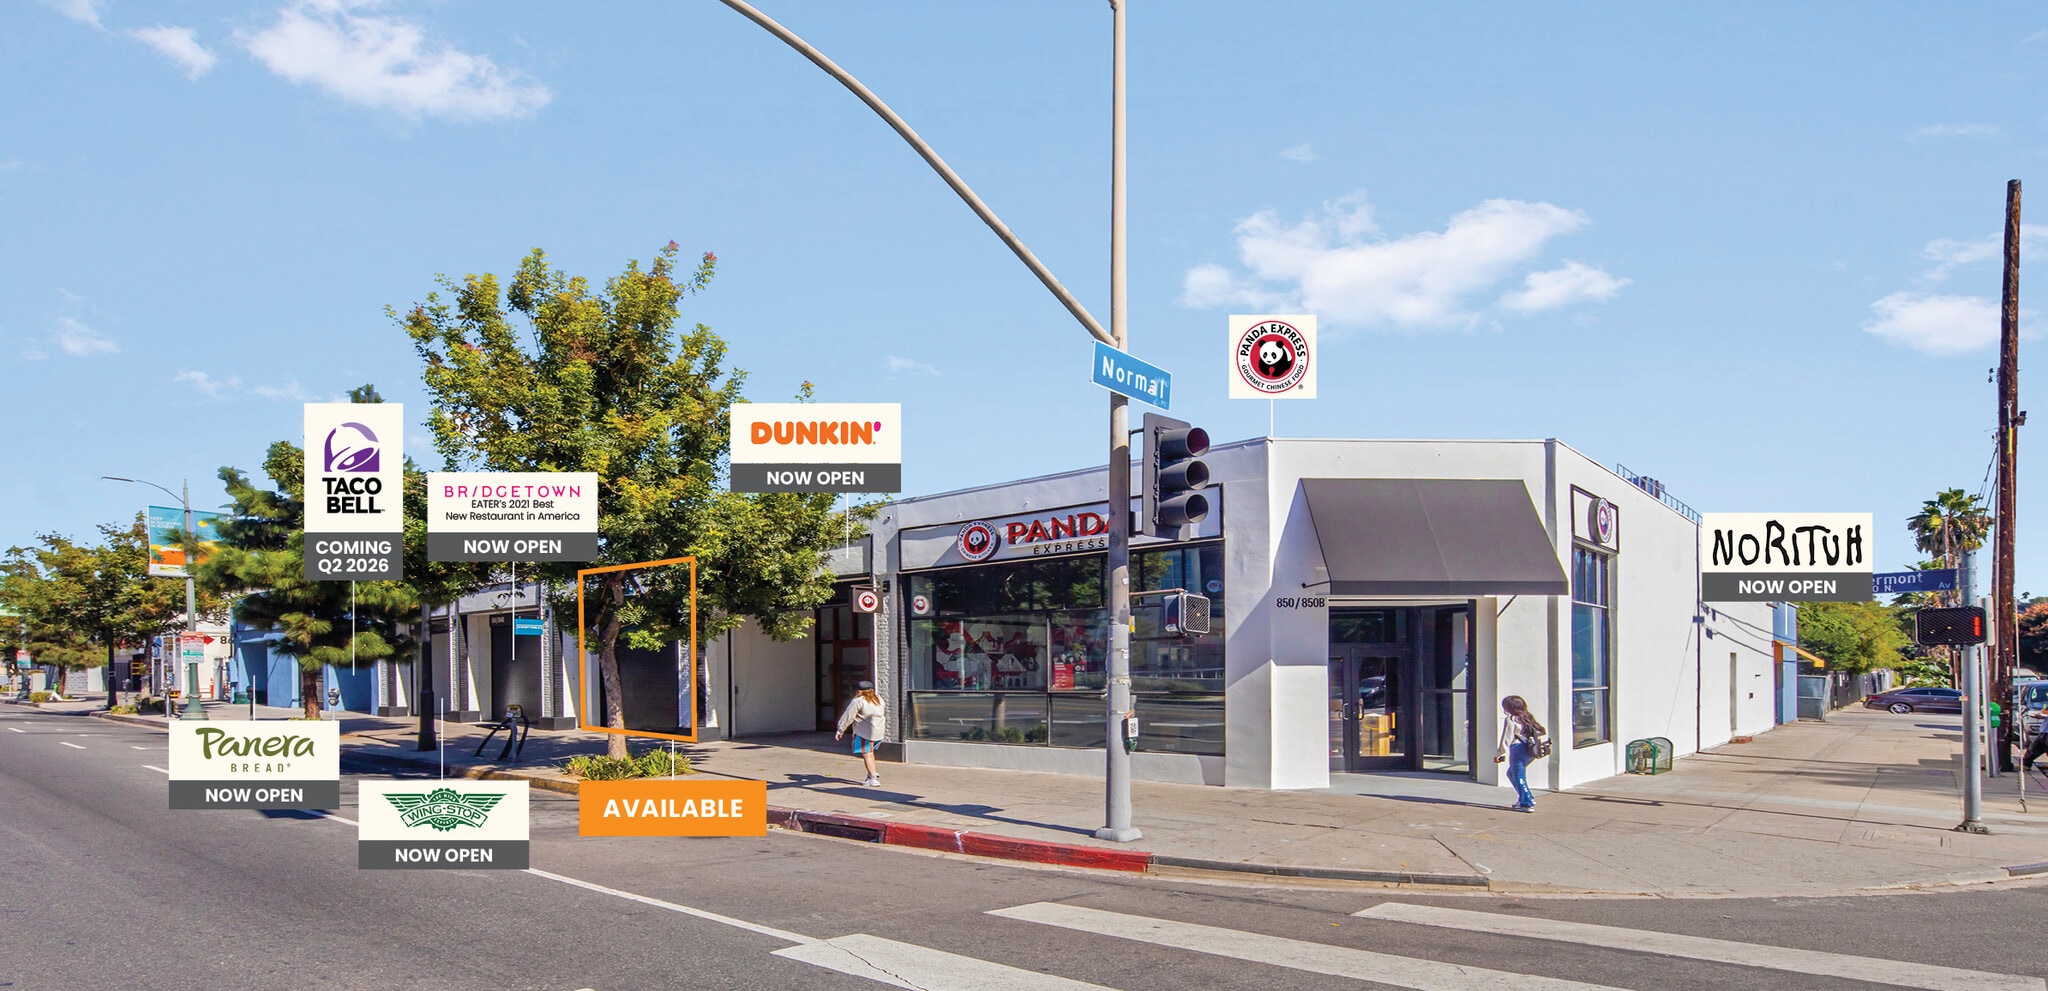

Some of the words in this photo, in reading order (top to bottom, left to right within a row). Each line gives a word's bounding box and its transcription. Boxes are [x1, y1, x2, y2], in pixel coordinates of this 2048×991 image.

[1102, 355, 1164, 399] Normal
[1006, 512, 1109, 545] PAND
[1033, 539, 1105, 555] EXPRESS
